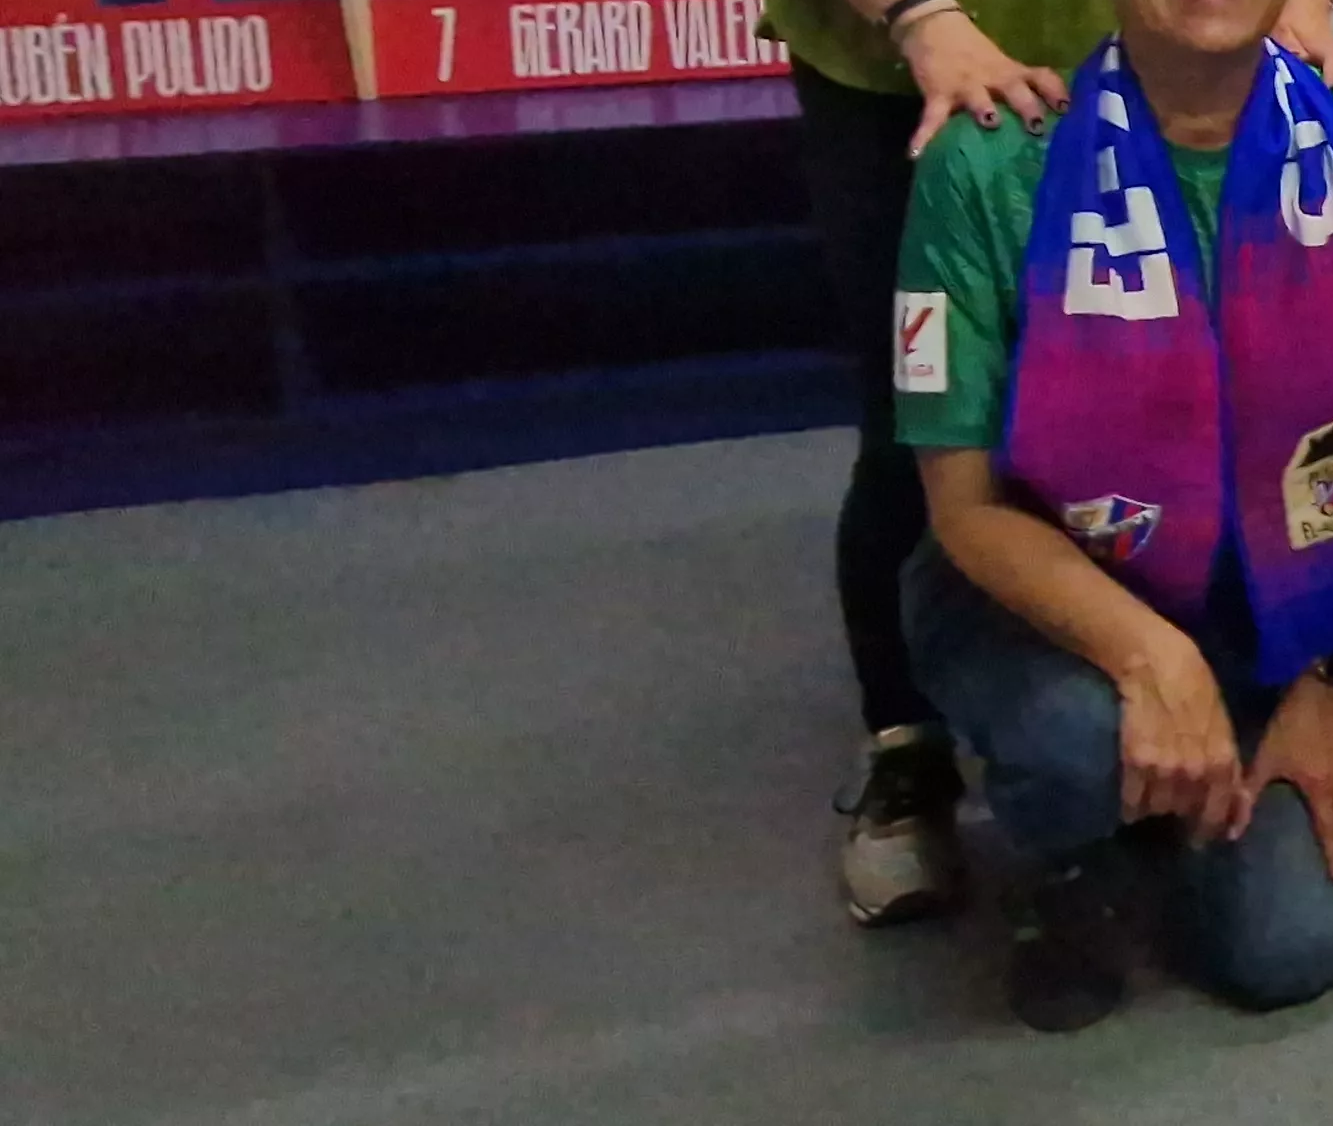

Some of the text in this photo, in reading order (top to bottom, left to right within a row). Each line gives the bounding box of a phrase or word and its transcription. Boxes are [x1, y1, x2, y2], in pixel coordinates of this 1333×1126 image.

[0, 12, 272, 105] UBÉN PULIDO
[431, 7, 457, 82] 7
[510, 0, 650, 77] GERARD
